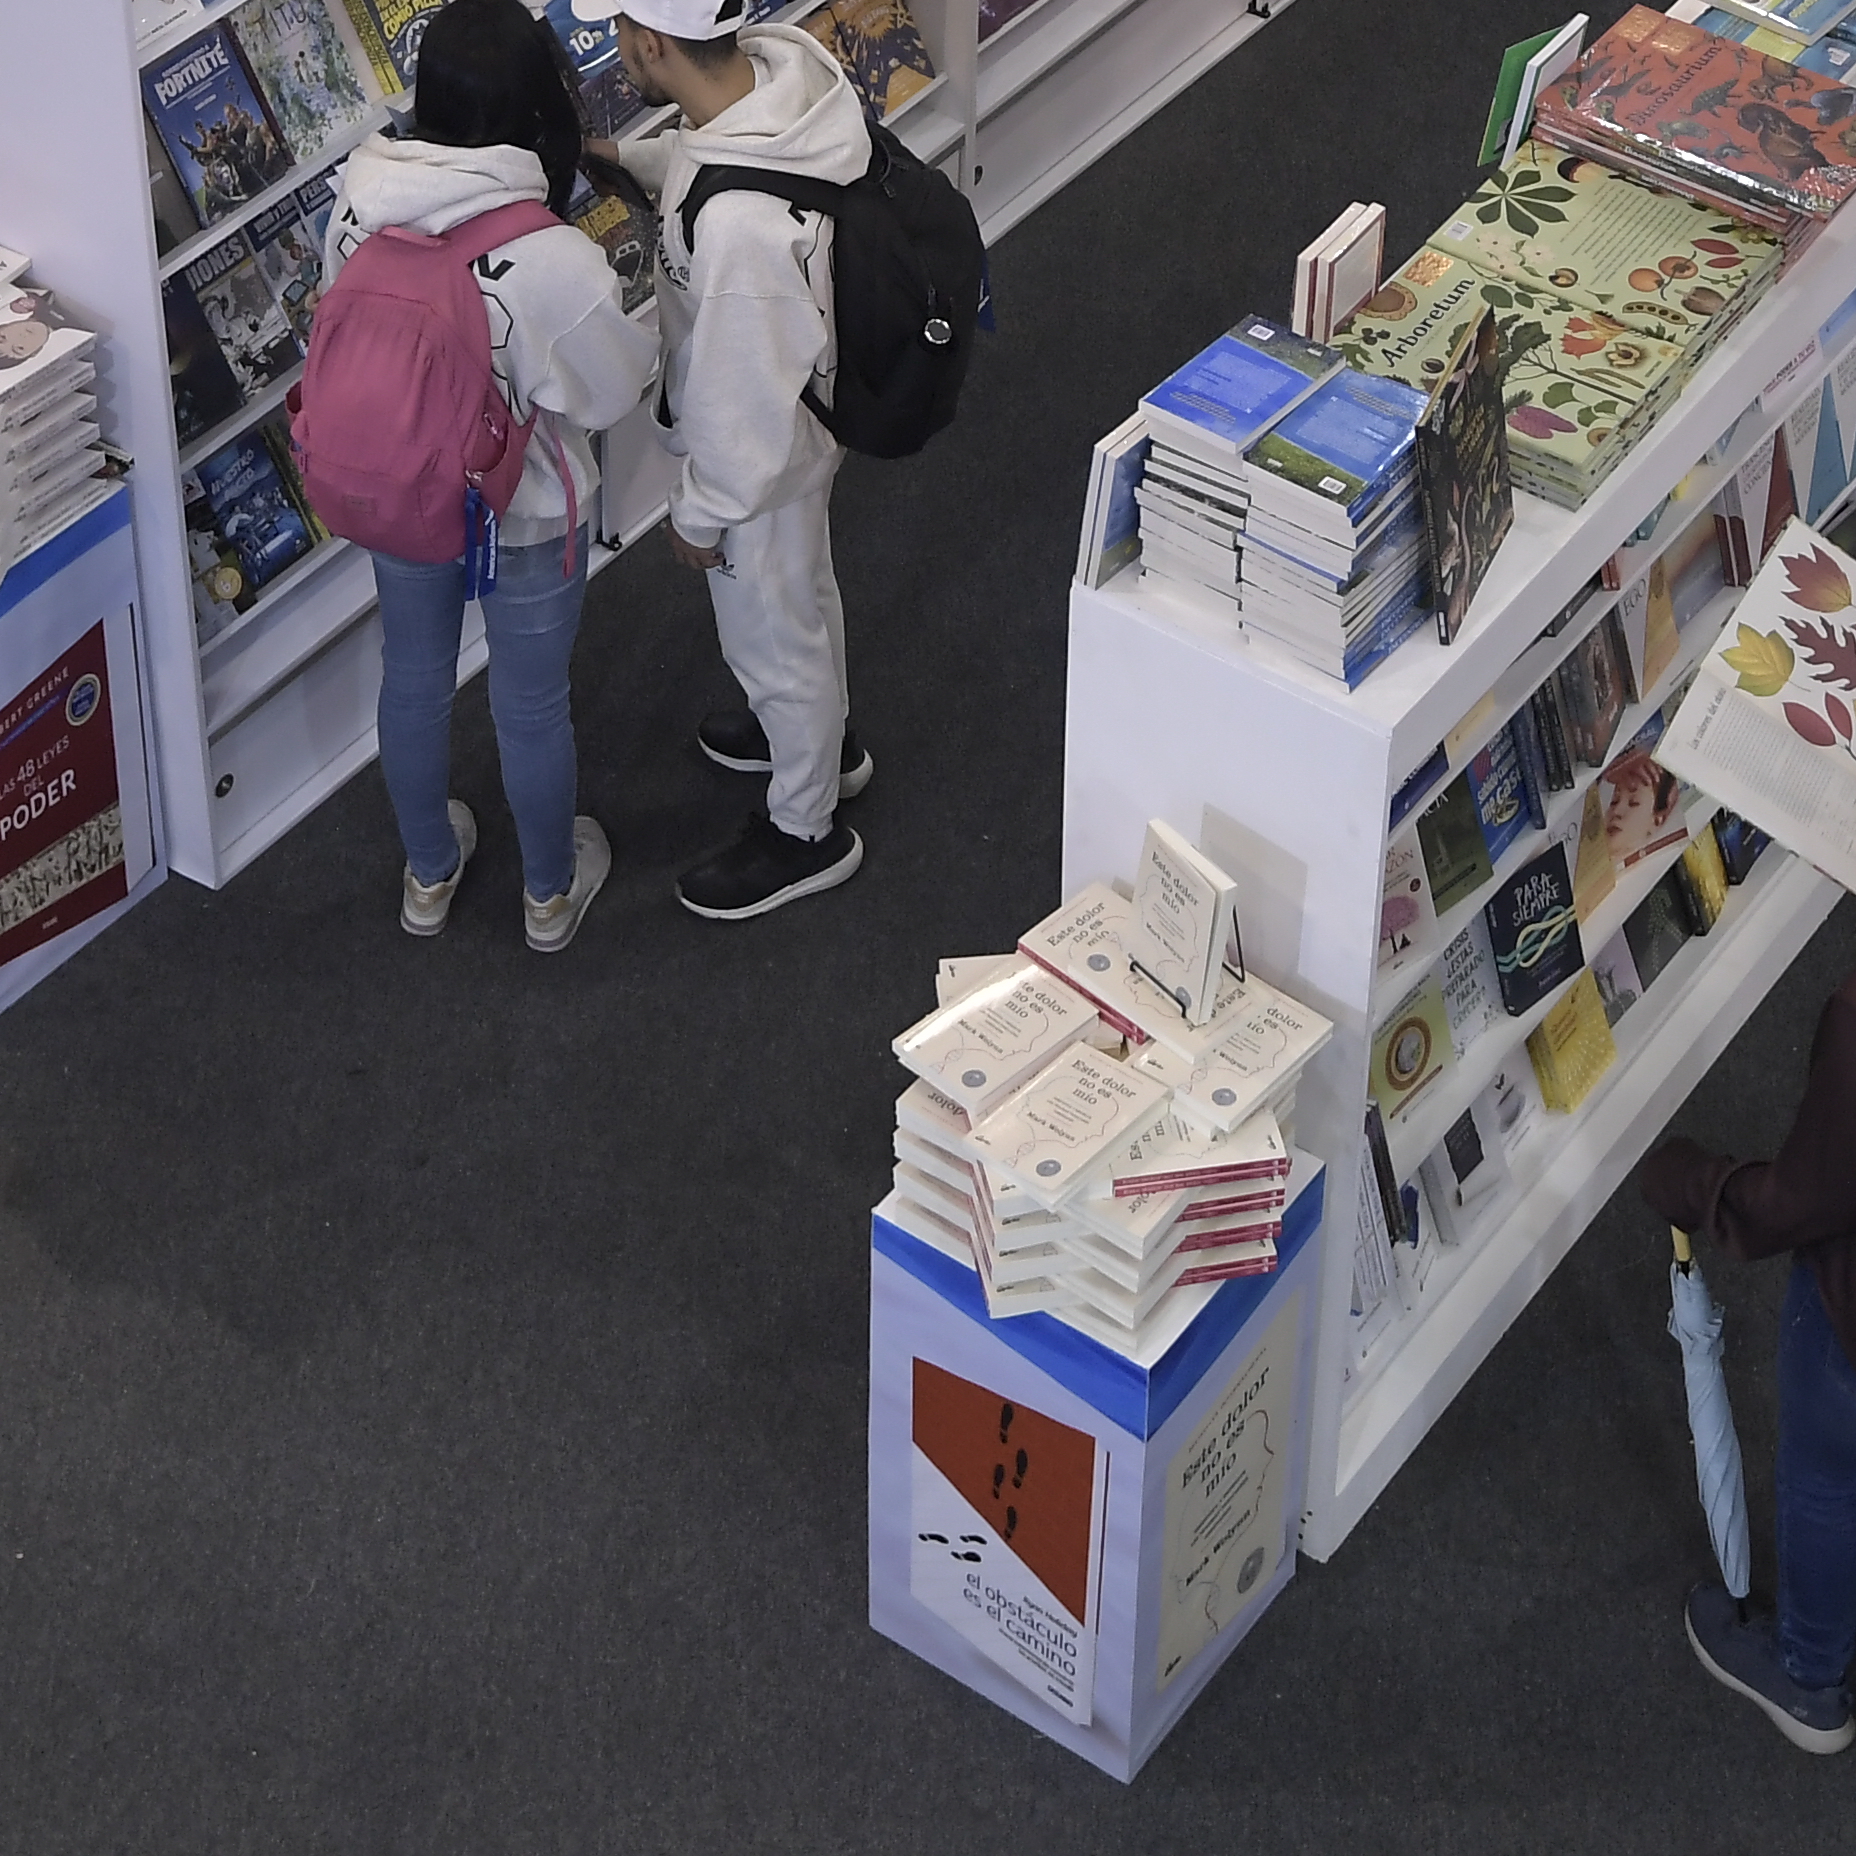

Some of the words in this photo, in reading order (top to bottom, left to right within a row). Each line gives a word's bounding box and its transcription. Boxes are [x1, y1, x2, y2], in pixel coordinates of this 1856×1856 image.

[155, 36, 230, 106] FORTNITE
[1629, 42, 1724, 127] Dinosaurium
[1380, 276, 1477, 368] Arboretum
[26, 667, 70, 709] GREENE
[17, 758, 35, 782] 48
[35, 736, 70, 771] LEYES
[0, 769, 77, 841] PODER
[24, 778, 45, 797] DEL
[1151, 851, 1170, 878] Este
[1171, 873, 1200, 908] dolor
[1512, 883, 1559, 927] SIEMPRE
[1515, 872, 1554, 906] PARA
[1047, 922, 1075, 948] Este
[1073, 901, 1106, 931] dolor
[1071, 1057, 1101, 1083] Este
[1102, 1071, 1137, 1100] dolor
[1072, 1086, 1098, 1107] mío
[1079, 1075, 1097, 1090] no
[1097, 1085, 1113, 1101] es
[1182, 1434, 1218, 1490] Este
[1220, 1367, 1270, 1437] dolor
[1200, 1452, 1222, 1485] no
[1226, 1419, 1246, 1442] es
[1204, 1452, 1237, 1499] mío
[1185, 1552, 1211, 1587] Mark
[1213, 1509, 1252, 1556] Wolynn
[963, 1590, 982, 1609] es
[986, 1601, 1002, 1623] el
[1006, 1619, 1077, 1677] camino
[966, 1571, 981, 1591] el
[985, 1585, 1078, 1659] obstáculo
